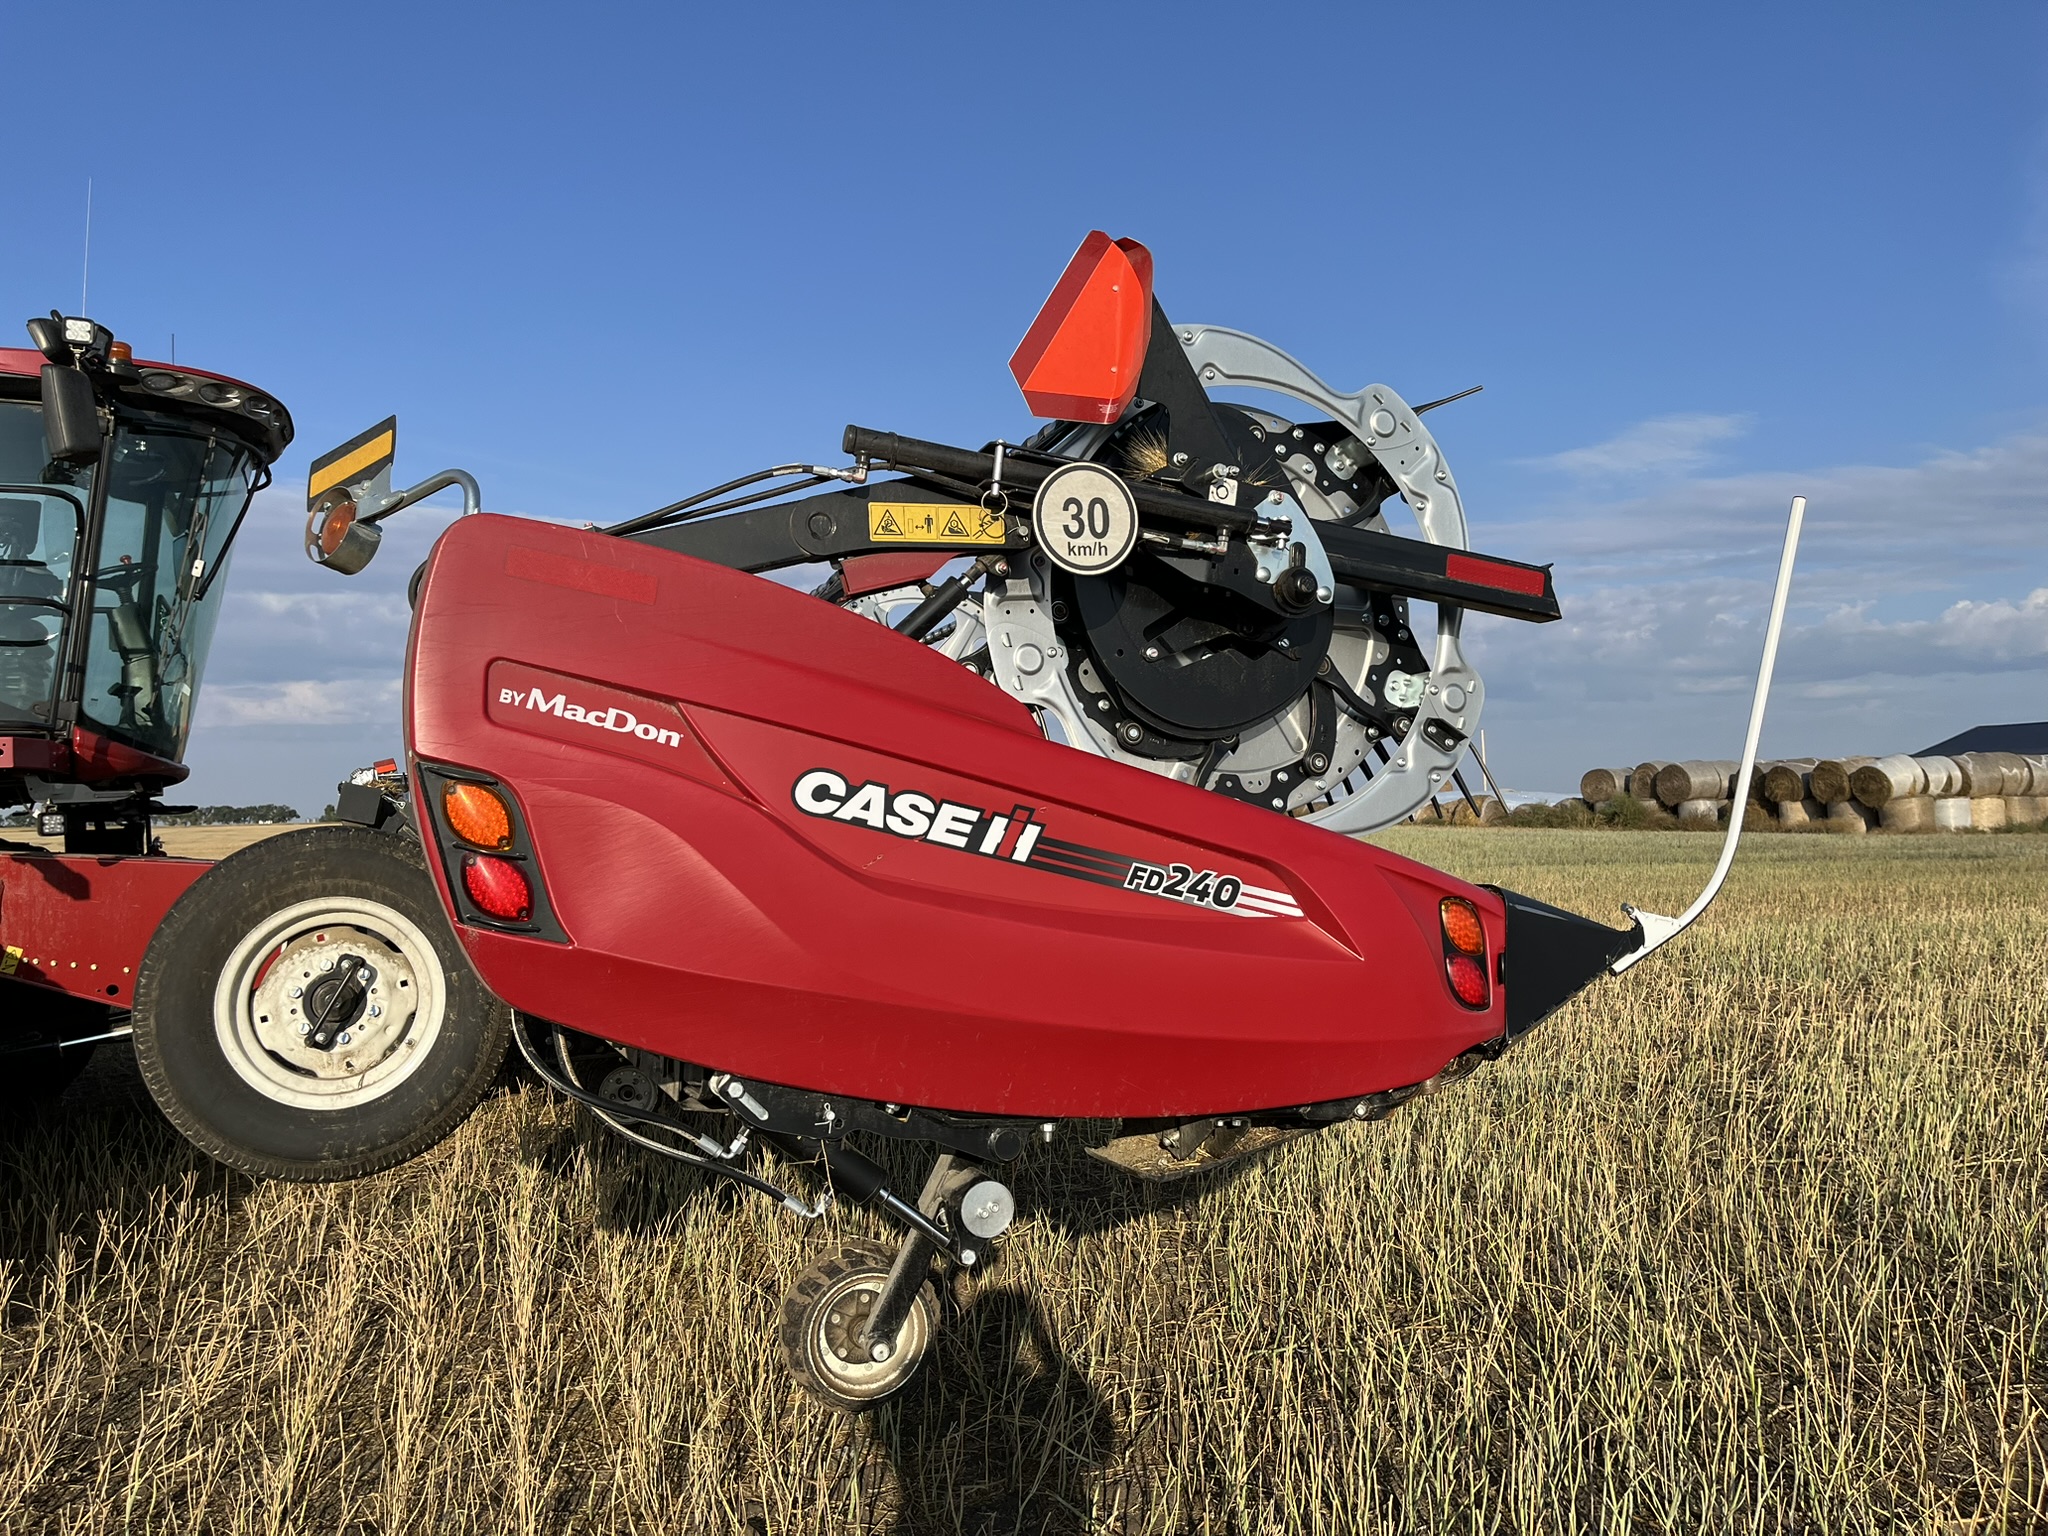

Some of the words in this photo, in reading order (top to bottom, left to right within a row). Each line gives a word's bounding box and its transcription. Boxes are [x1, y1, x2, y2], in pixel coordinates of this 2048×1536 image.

[1062, 496, 1110, 540] 30
[1066, 541, 1109, 557] km/h
[498, 688, 526, 707] BY
[525, 687, 683, 748] MacDon
[794, 770, 981, 848] CASE
[1124, 863, 1242, 909] FD240
